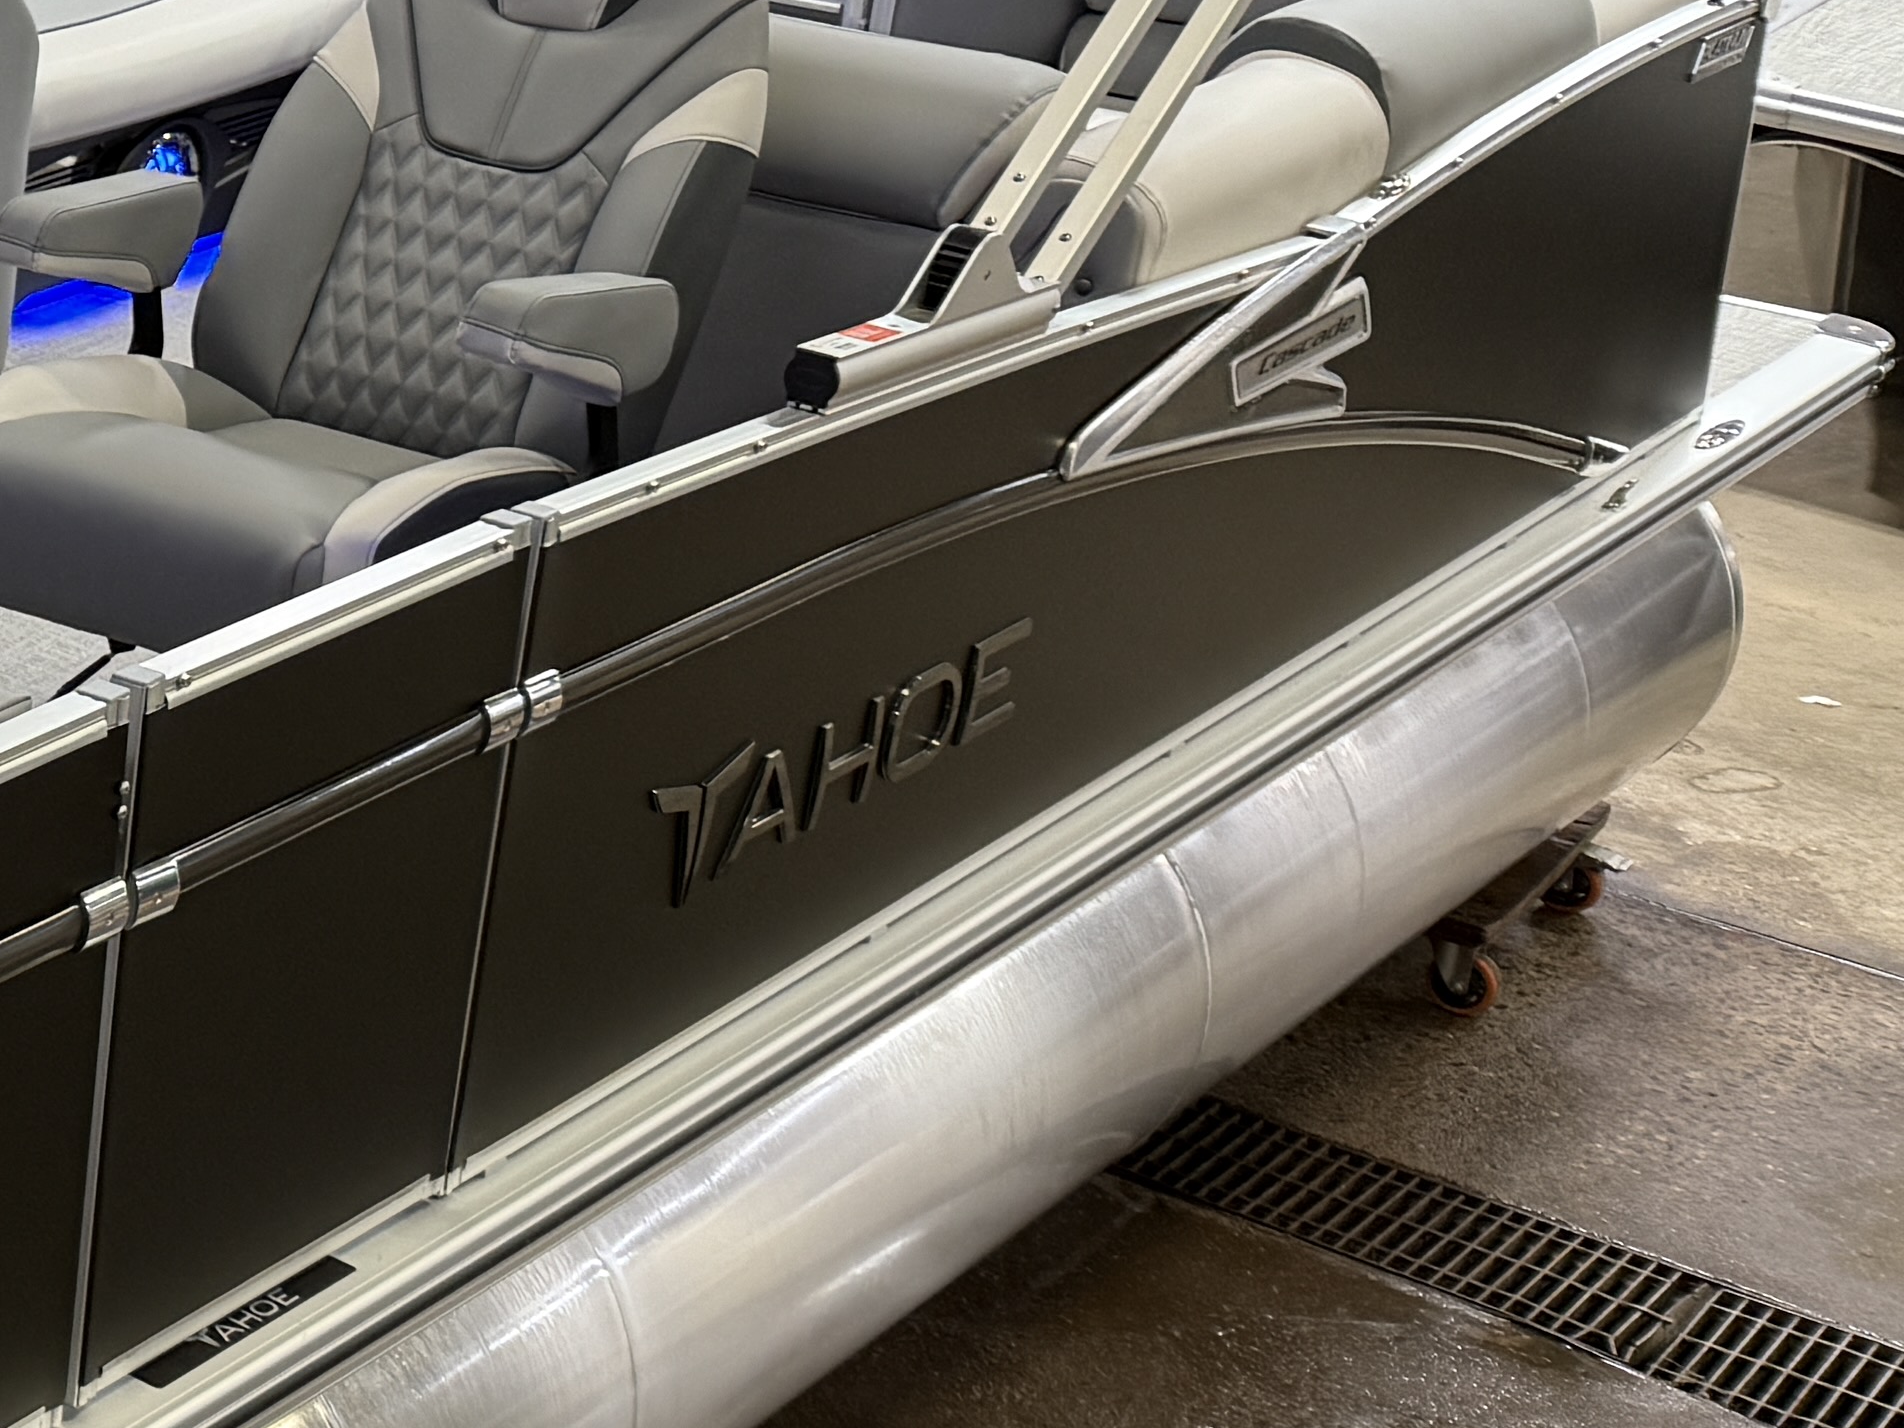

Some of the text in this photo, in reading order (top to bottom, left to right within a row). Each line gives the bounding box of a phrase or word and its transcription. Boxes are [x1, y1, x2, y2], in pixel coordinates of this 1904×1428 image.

[1258, 314, 1356, 376] Cascade
[649, 617, 1033, 909] TAHOE
[185, 1287, 300, 1348] TAHOE
